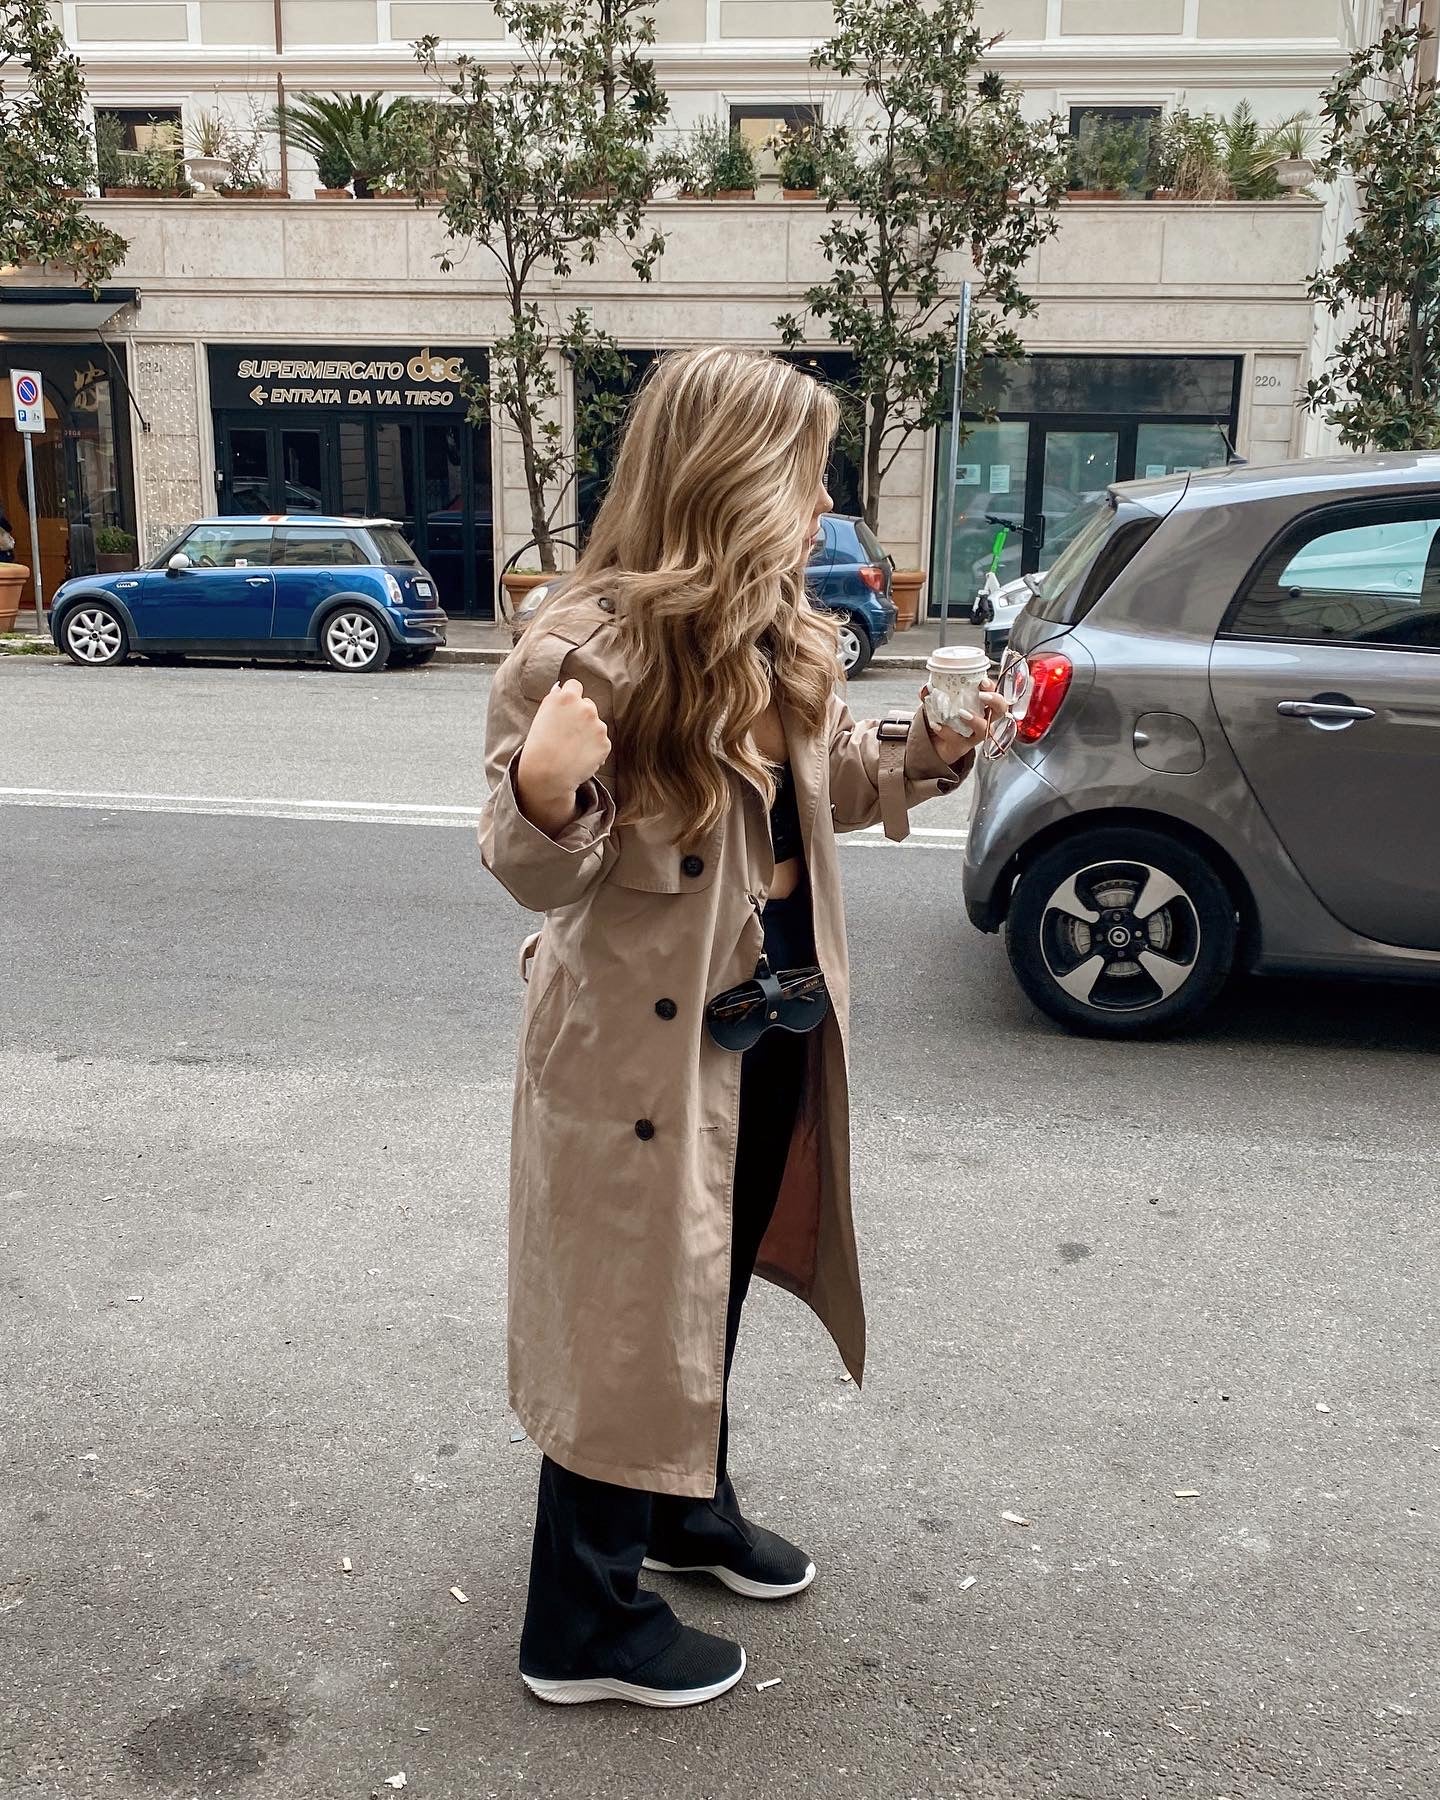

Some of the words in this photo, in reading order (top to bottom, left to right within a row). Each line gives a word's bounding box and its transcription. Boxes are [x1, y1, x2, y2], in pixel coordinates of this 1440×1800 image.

[238, 360, 403, 380] SUPERMERCATO
[270, 388, 341, 404] ENTRATA
[348, 389, 372, 404] DA
[376, 390, 402, 405] VIA
[404, 390, 454, 406] TIRSO
